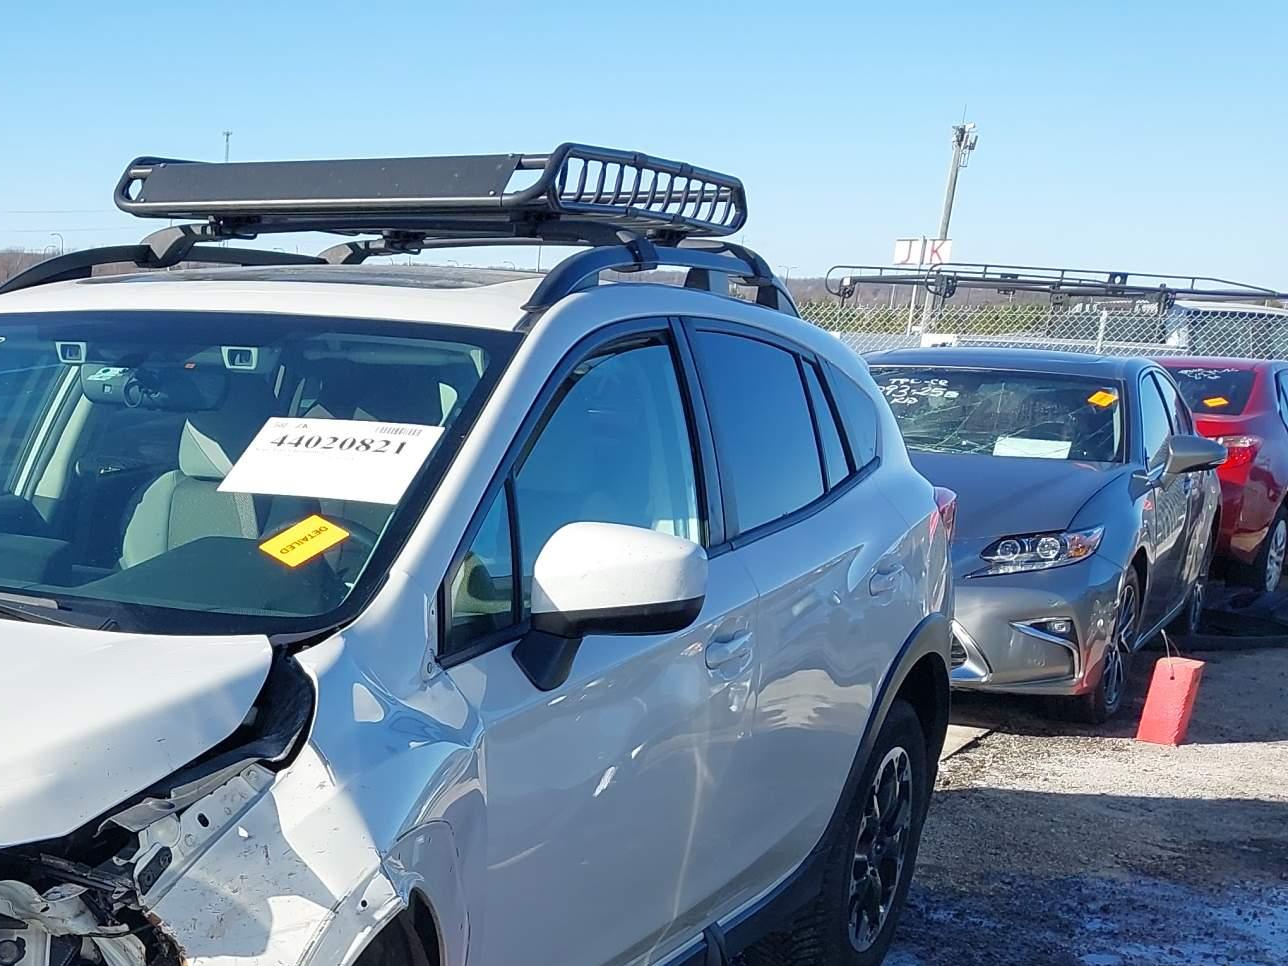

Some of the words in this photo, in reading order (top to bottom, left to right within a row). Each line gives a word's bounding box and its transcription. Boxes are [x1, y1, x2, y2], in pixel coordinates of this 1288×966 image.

[929, 240, 945, 264] K
[269, 433, 408, 456] 44020821
[279, 526, 329, 554] DETAILED
